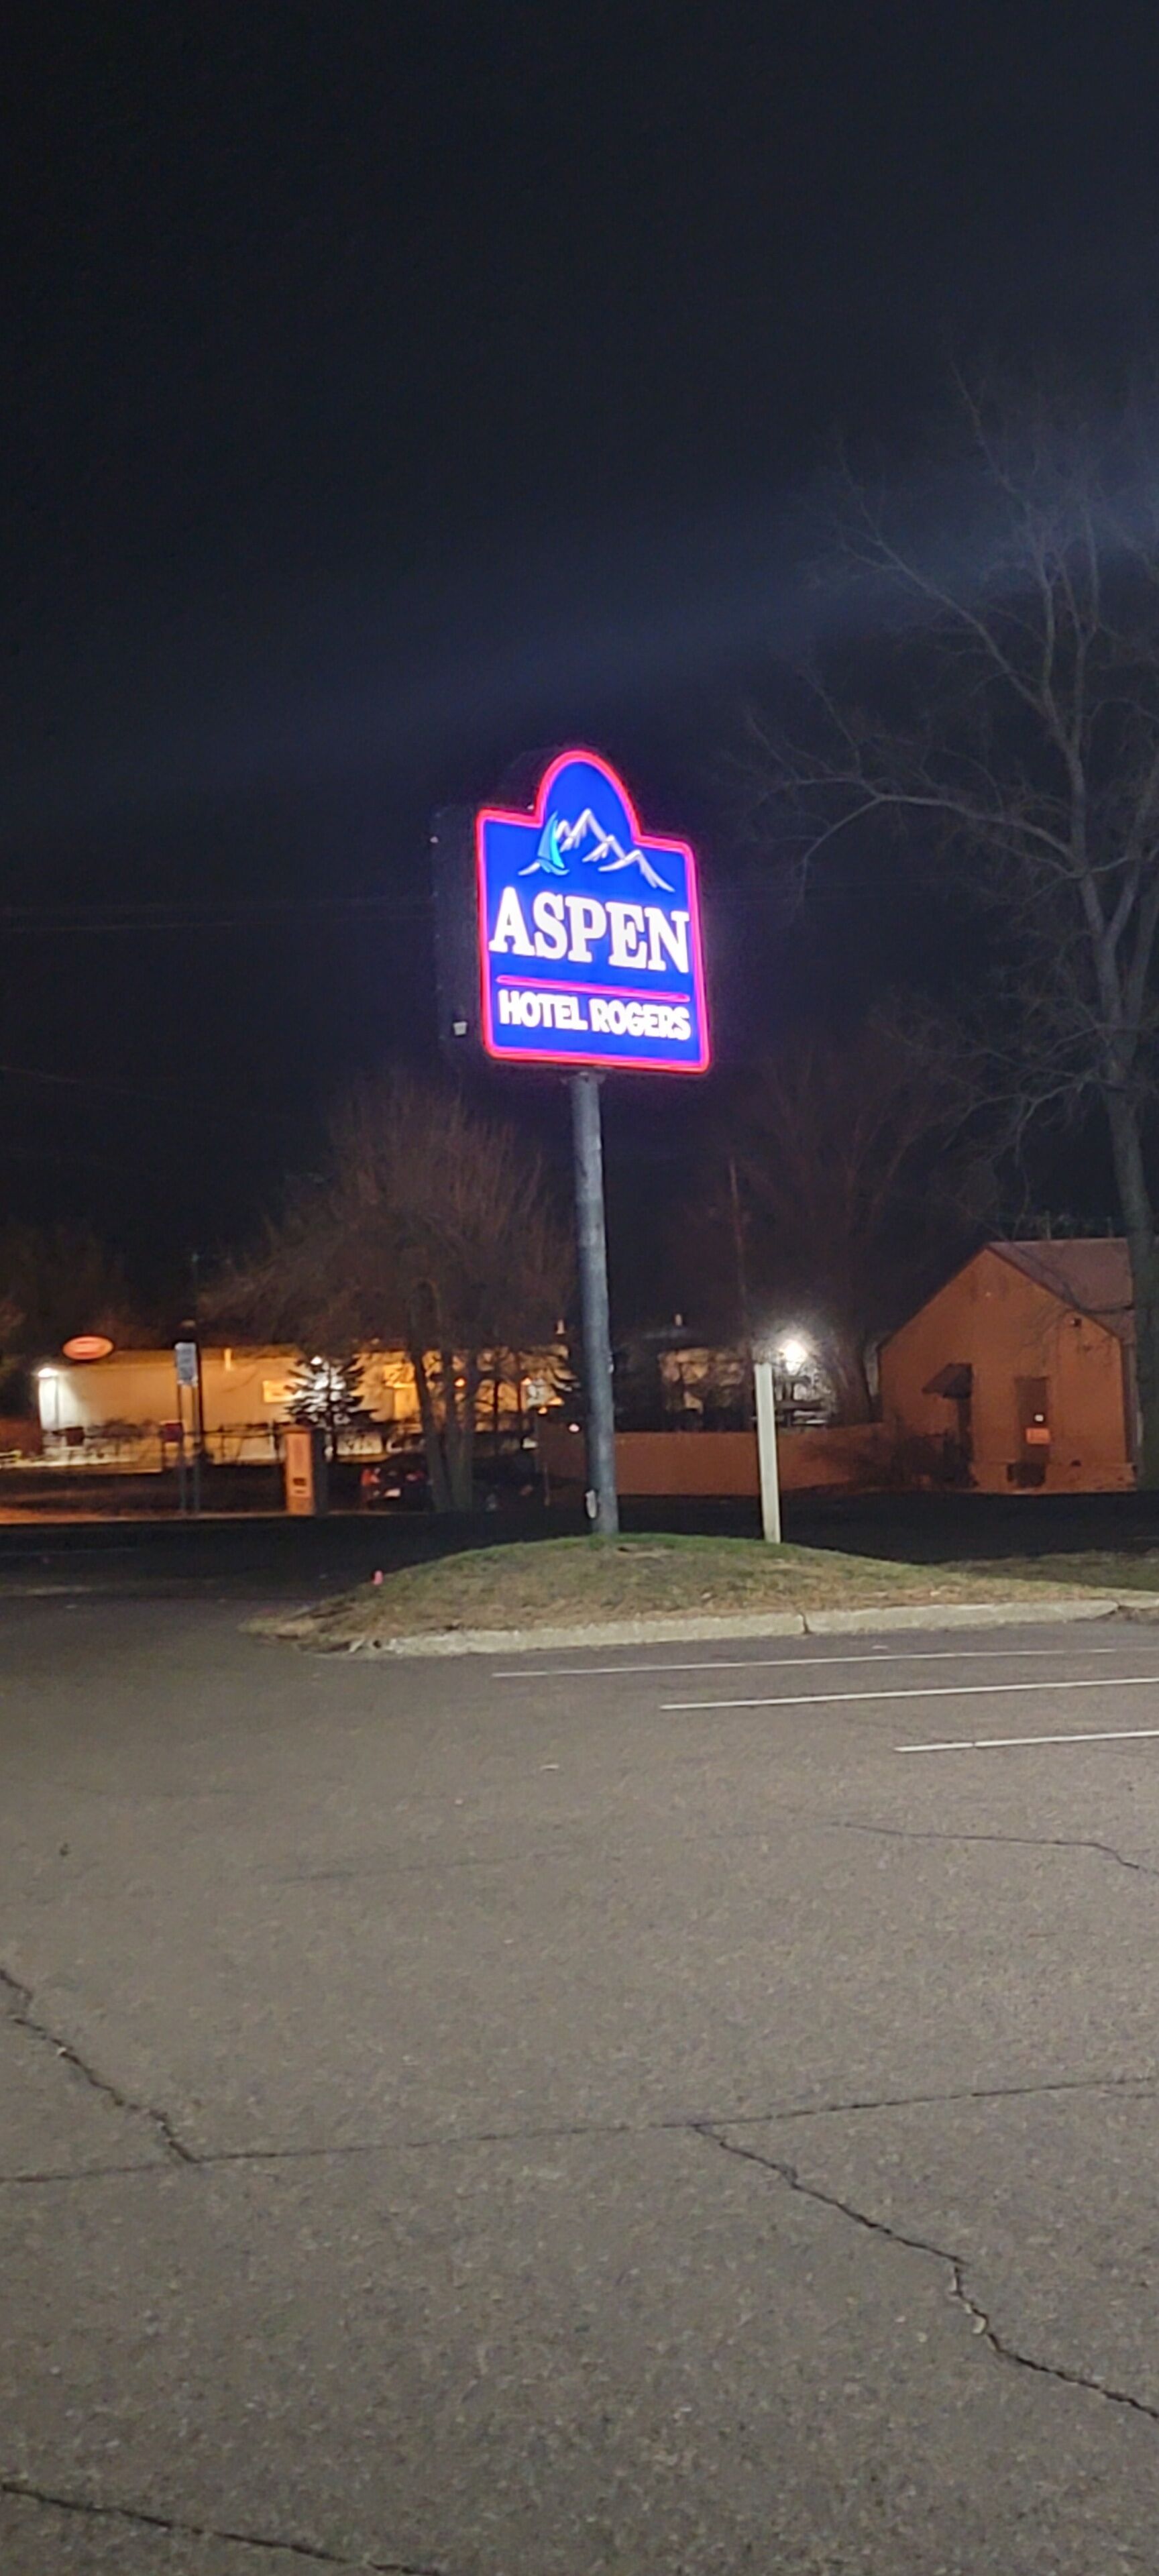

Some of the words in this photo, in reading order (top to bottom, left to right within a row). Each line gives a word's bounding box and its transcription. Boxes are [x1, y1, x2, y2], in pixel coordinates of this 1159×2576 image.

[488, 886, 689, 973] ASPEN
[498, 989, 588, 1030] HOTEL
[591, 998, 691, 1040] ROGERS
